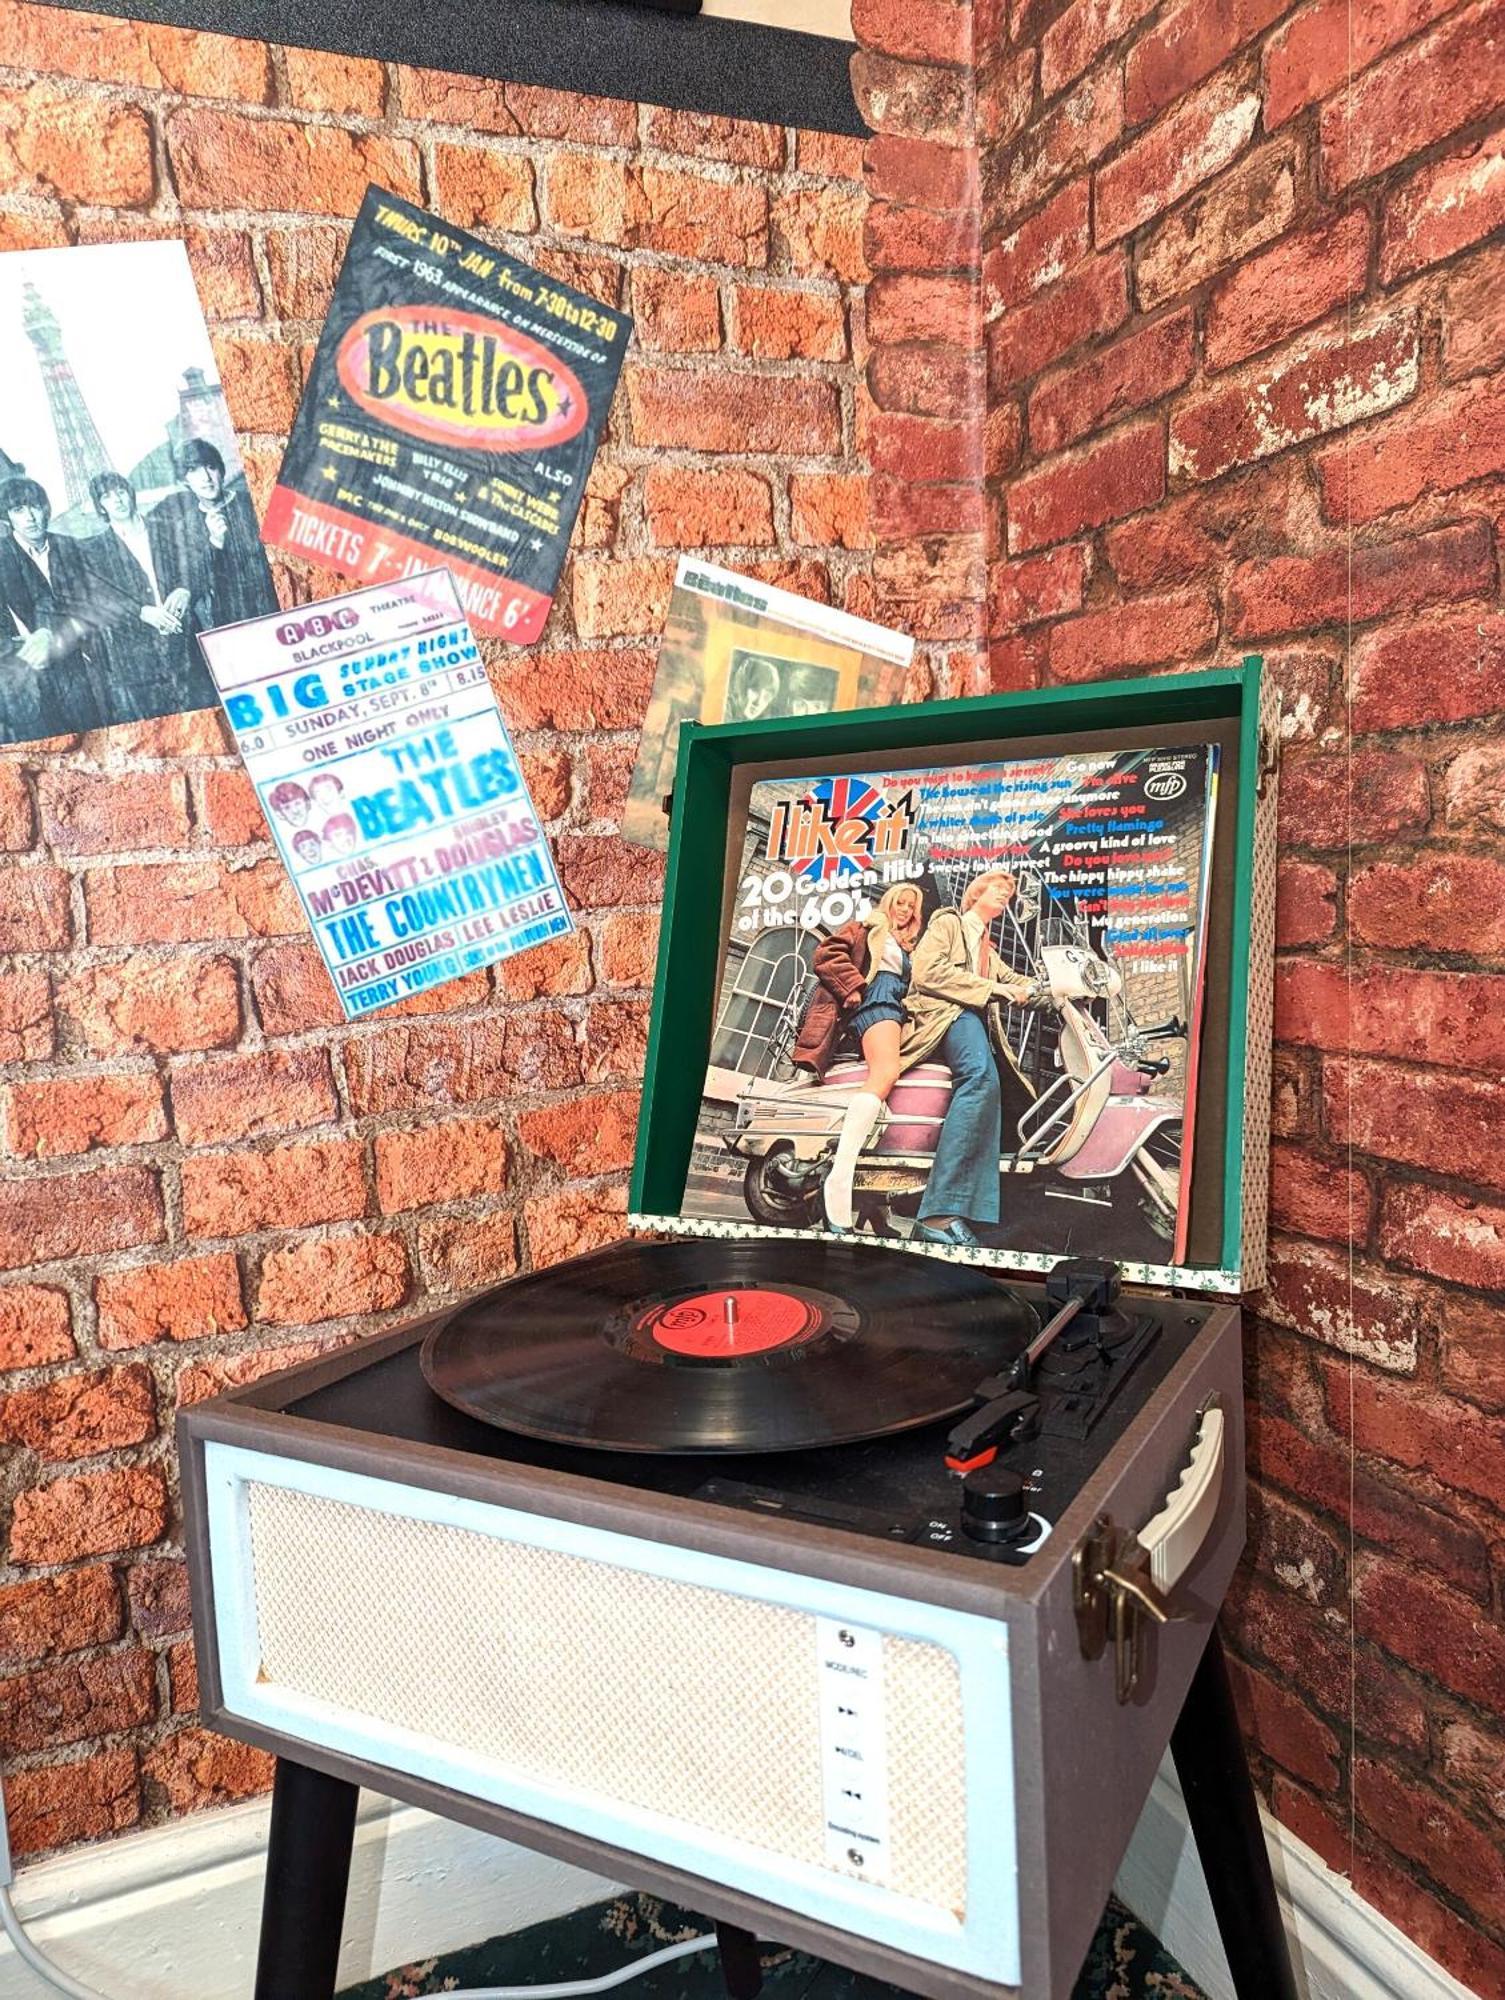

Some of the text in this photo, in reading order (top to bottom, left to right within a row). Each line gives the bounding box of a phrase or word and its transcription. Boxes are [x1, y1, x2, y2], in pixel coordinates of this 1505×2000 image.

[458, 250, 495, 280] JAN
[498, 266, 534, 302] from
[372, 246, 411, 269] FIRST
[413, 257, 442, 285] 1963
[441, 280, 511, 320] APPEARANCE
[513, 314, 529, 331] ON
[588, 350, 608, 365] OF
[411, 319, 454, 338] THE
[363, 320, 555, 425] Beatles
[370, 436, 400, 455] THE
[412, 452, 443, 475] BILLY
[533, 461, 574, 487] ALSO
[423, 469, 454, 491] TRIO
[286, 509, 364, 566] TICKETS
[369, 594, 417, 613] THEATRE
[280, 608, 360, 645] ABC
[292, 631, 375, 664] BLACKPOOL
[339, 627, 470, 679] SUNDAY NIGHT
[342, 645, 478, 698] STAGE SHOW
[455, 665, 487, 687] 8.15
[225, 674, 330, 731] BIG
[285, 705, 368, 739] SUNDAY,
[370, 688, 418, 714] SEPT.
[302, 704, 451, 764] ONE NIGHT ONLY
[379, 728, 460, 774] THE
[1066, 759, 1119, 774] Go now
[882, 777, 898, 788] Do
[899, 776, 922, 789] you
[952, 772, 965, 783] to
[942, 785, 978, 798] house
[1013, 779, 1049, 793] rising
[1049, 778, 1072, 790] sun
[1150, 775, 1181, 796] mfp
[350, 747, 521, 842] BEATLES
[1062, 790, 1121, 806] anymore
[1018, 809, 1046, 825] pale
[1084, 804, 1118, 819] loves
[1119, 804, 1147, 819] you
[765, 803, 911, 861] I like it
[1020, 825, 1054, 841] good
[1064, 816, 1166, 837] Pretty flamingo
[433, 817, 540, 872] DOUGLAS
[1039, 840, 1051, 853] A
[1051, 838, 1099, 855] groovy
[1100, 835, 1132, 850] kind
[1131, 833, 1146, 847] of
[1147, 833, 1178, 846] love
[1062, 853, 1083, 867] Do
[1083, 852, 1110, 868] you
[740, 858, 926, 908] 20 Golden Hits
[1043, 864, 1187, 885] The hippy hippy shake
[1072, 886, 1106, 898] were
[325, 848, 548, 962] THE COUNTRYMEN
[738, 890, 873, 931] of the 60's
[1078, 898, 1108, 914] Can't
[1091, 911, 1189, 930] My generation
[337, 961, 381, 989] JACK
[384, 931, 457, 969] DOUGLAS
[462, 918, 496, 943] LEE
[500, 894, 556, 929] LESLIE
[1140, 959, 1165, 974] like
[345, 980, 399, 1013] TERRY
[400, 959, 458, 991] YOUNG
[929, 1520, 948, 1530] ON
[929, 1532, 953, 1543] OFF
